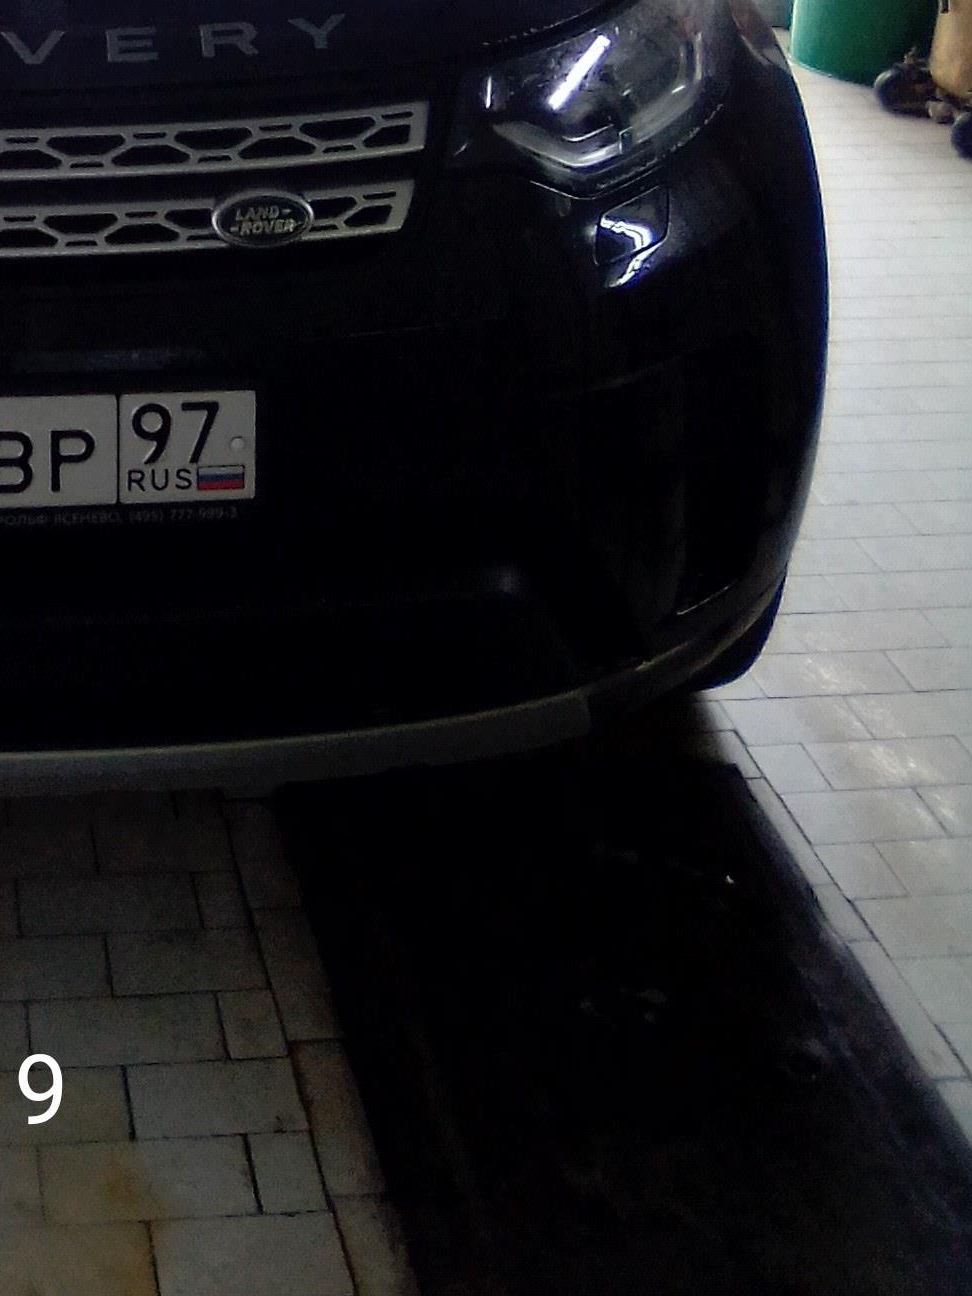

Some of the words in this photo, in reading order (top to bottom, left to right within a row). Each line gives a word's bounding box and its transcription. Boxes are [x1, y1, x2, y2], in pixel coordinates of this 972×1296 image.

[236, 205, 280, 221] LAND
[239, 218, 297, 236] ROVER
[131, 401, 220, 465] 97
[127, 468, 192, 492] RUS
